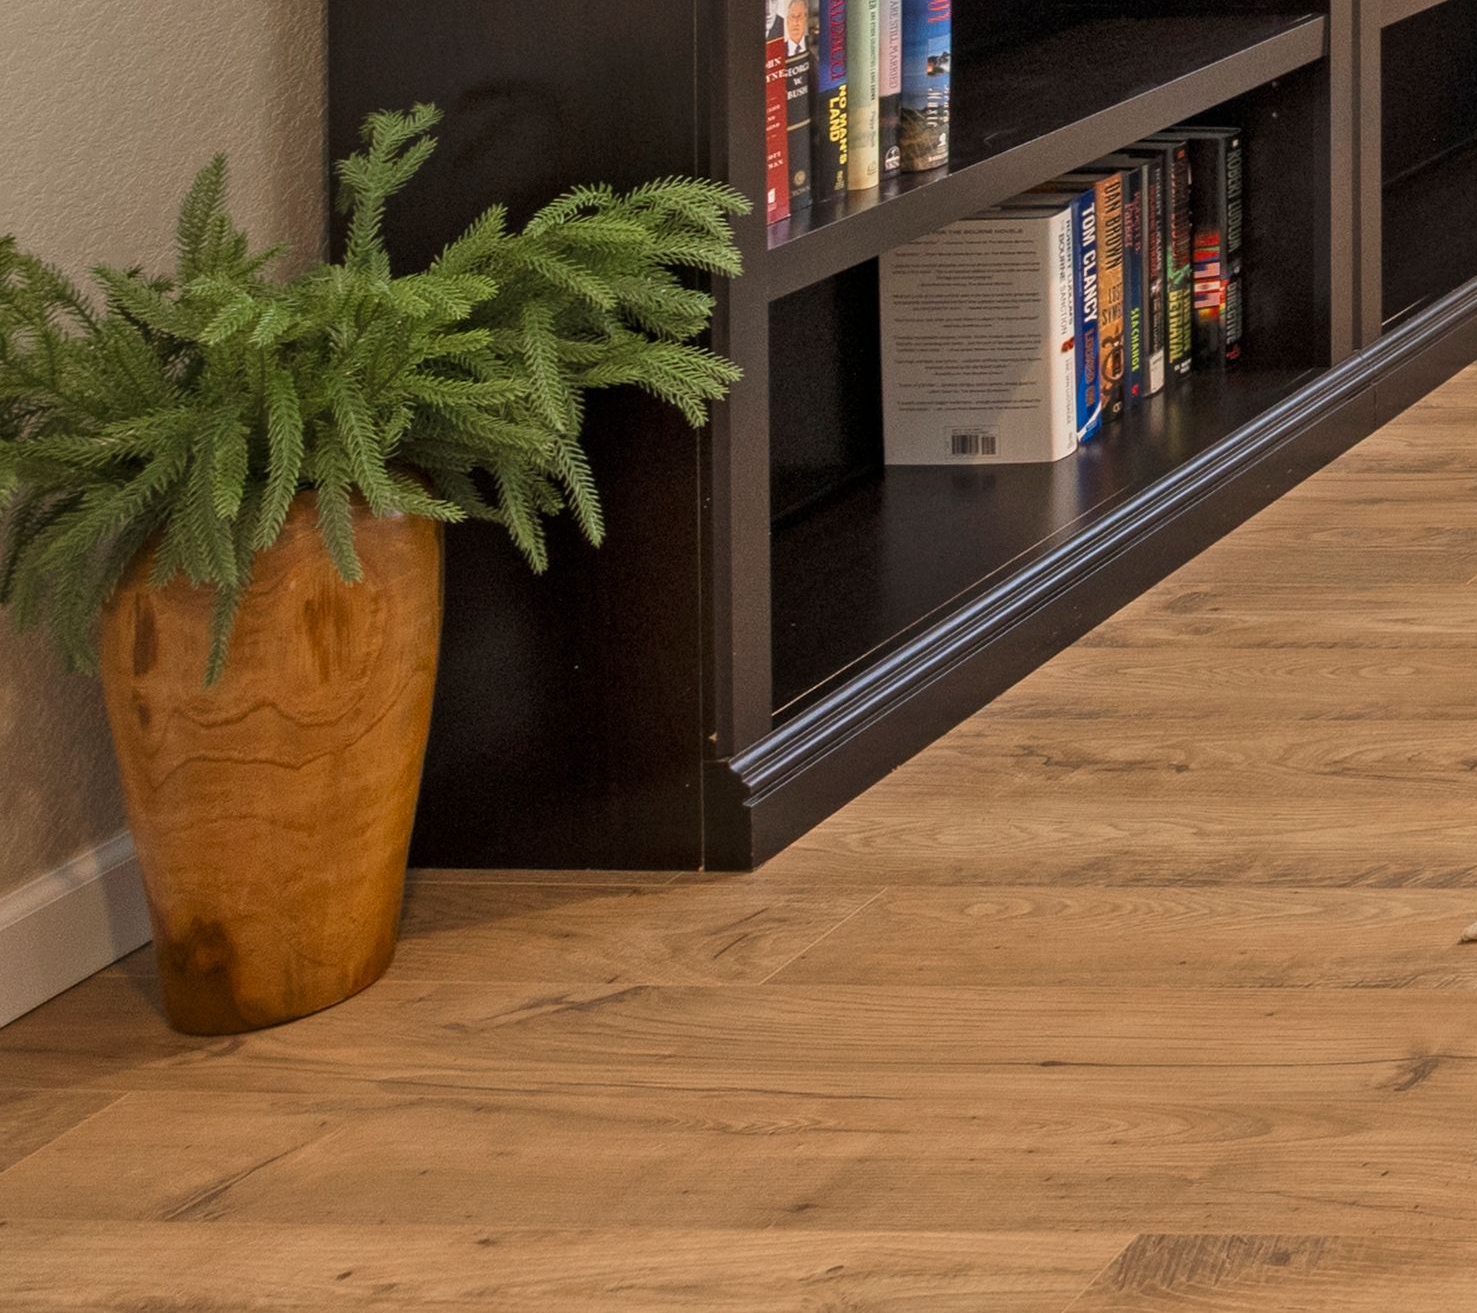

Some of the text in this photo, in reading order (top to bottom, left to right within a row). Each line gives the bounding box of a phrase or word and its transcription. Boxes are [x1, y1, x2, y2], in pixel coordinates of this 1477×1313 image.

[888, 20, 899, 43] STILL
[889, 1, 899, 19] ARE
[786, 86, 808, 100] BUSH
[888, 45, 899, 89] MARRIED
[828, 97, 840, 142] LAND
[838, 84, 848, 164] NO MAN'S
[926, 87, 943, 127] Music
[1103, 180, 1124, 272] DAN BROWN
[1124, 202, 1135, 248] Parker
[1227, 149, 1243, 253] ROBERT LUDLUM
[1057, 233, 1069, 335] BOURNE SANCTION
[1082, 202, 1098, 324] TOM CLANCY
[1130, 308, 1141, 372] SEA CHANGE
[1169, 291, 1184, 364] BETRAYAL
[1226, 280, 1239, 345] DIRECTIVE
